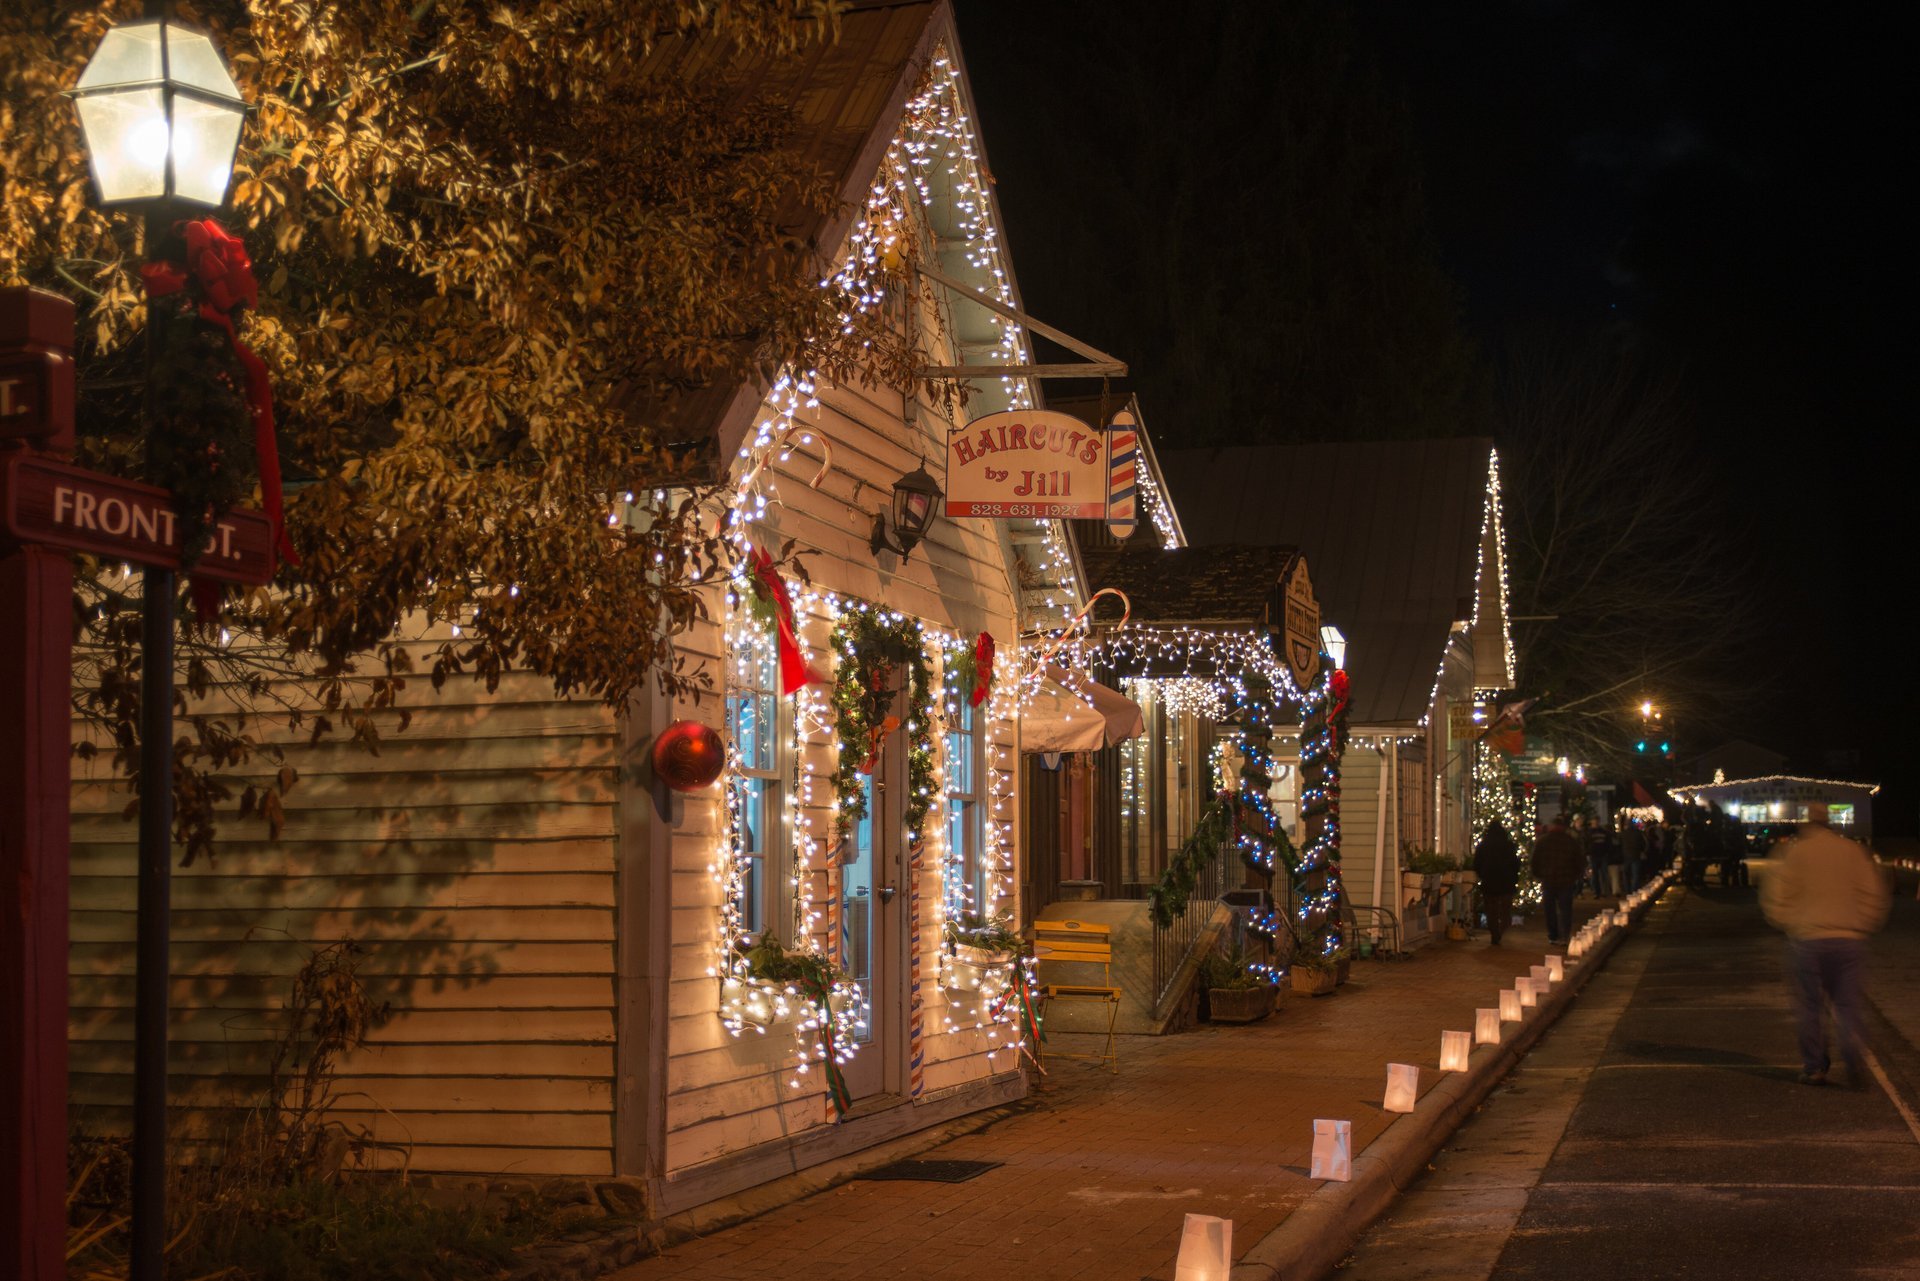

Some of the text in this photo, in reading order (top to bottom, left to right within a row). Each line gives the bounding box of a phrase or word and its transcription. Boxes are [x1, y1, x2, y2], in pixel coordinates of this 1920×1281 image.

[952, 423, 1103, 467] HAIRCUTS
[984, 466, 1072, 497] by Jill
[53, 486, 178, 547] FRONT
[970, 504, 1081, 517] 828-631-1927
